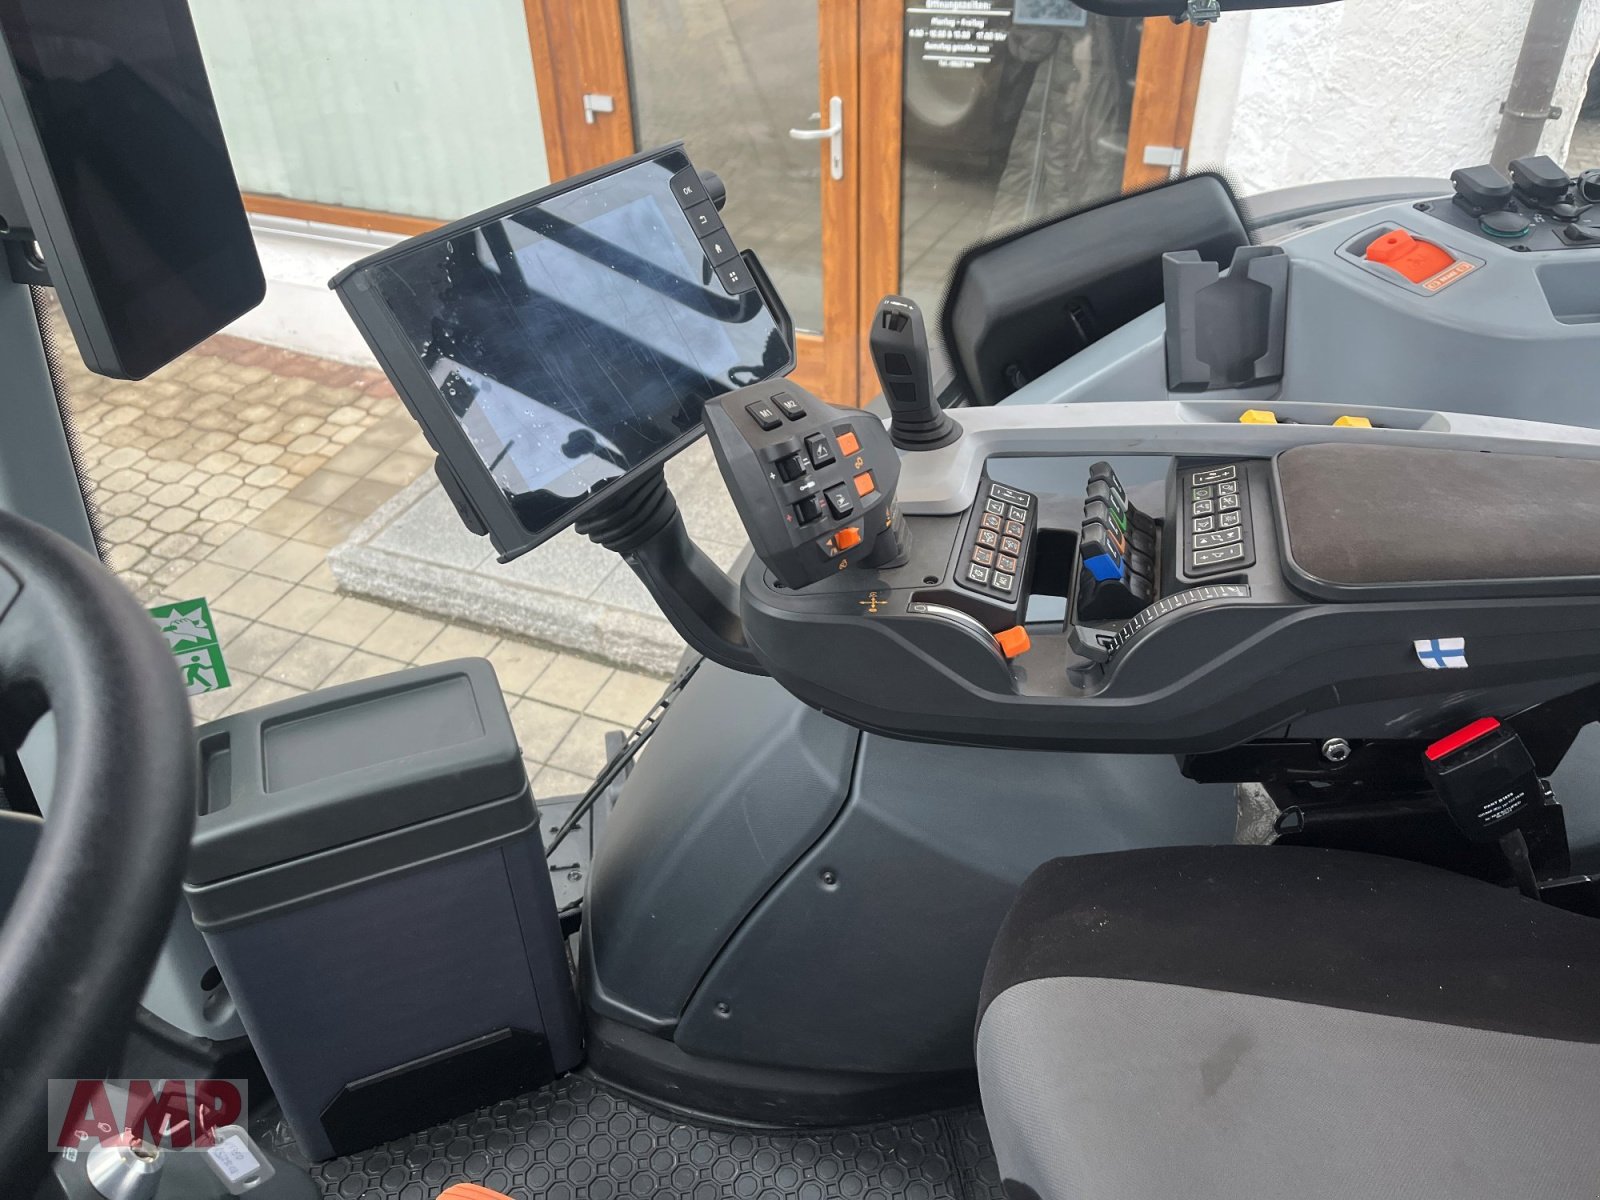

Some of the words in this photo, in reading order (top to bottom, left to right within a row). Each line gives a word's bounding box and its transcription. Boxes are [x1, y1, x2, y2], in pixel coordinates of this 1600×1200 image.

[683, 186, 693, 194] OK
[783, 400, 797, 409] M2
[759, 409, 773, 418] M1
